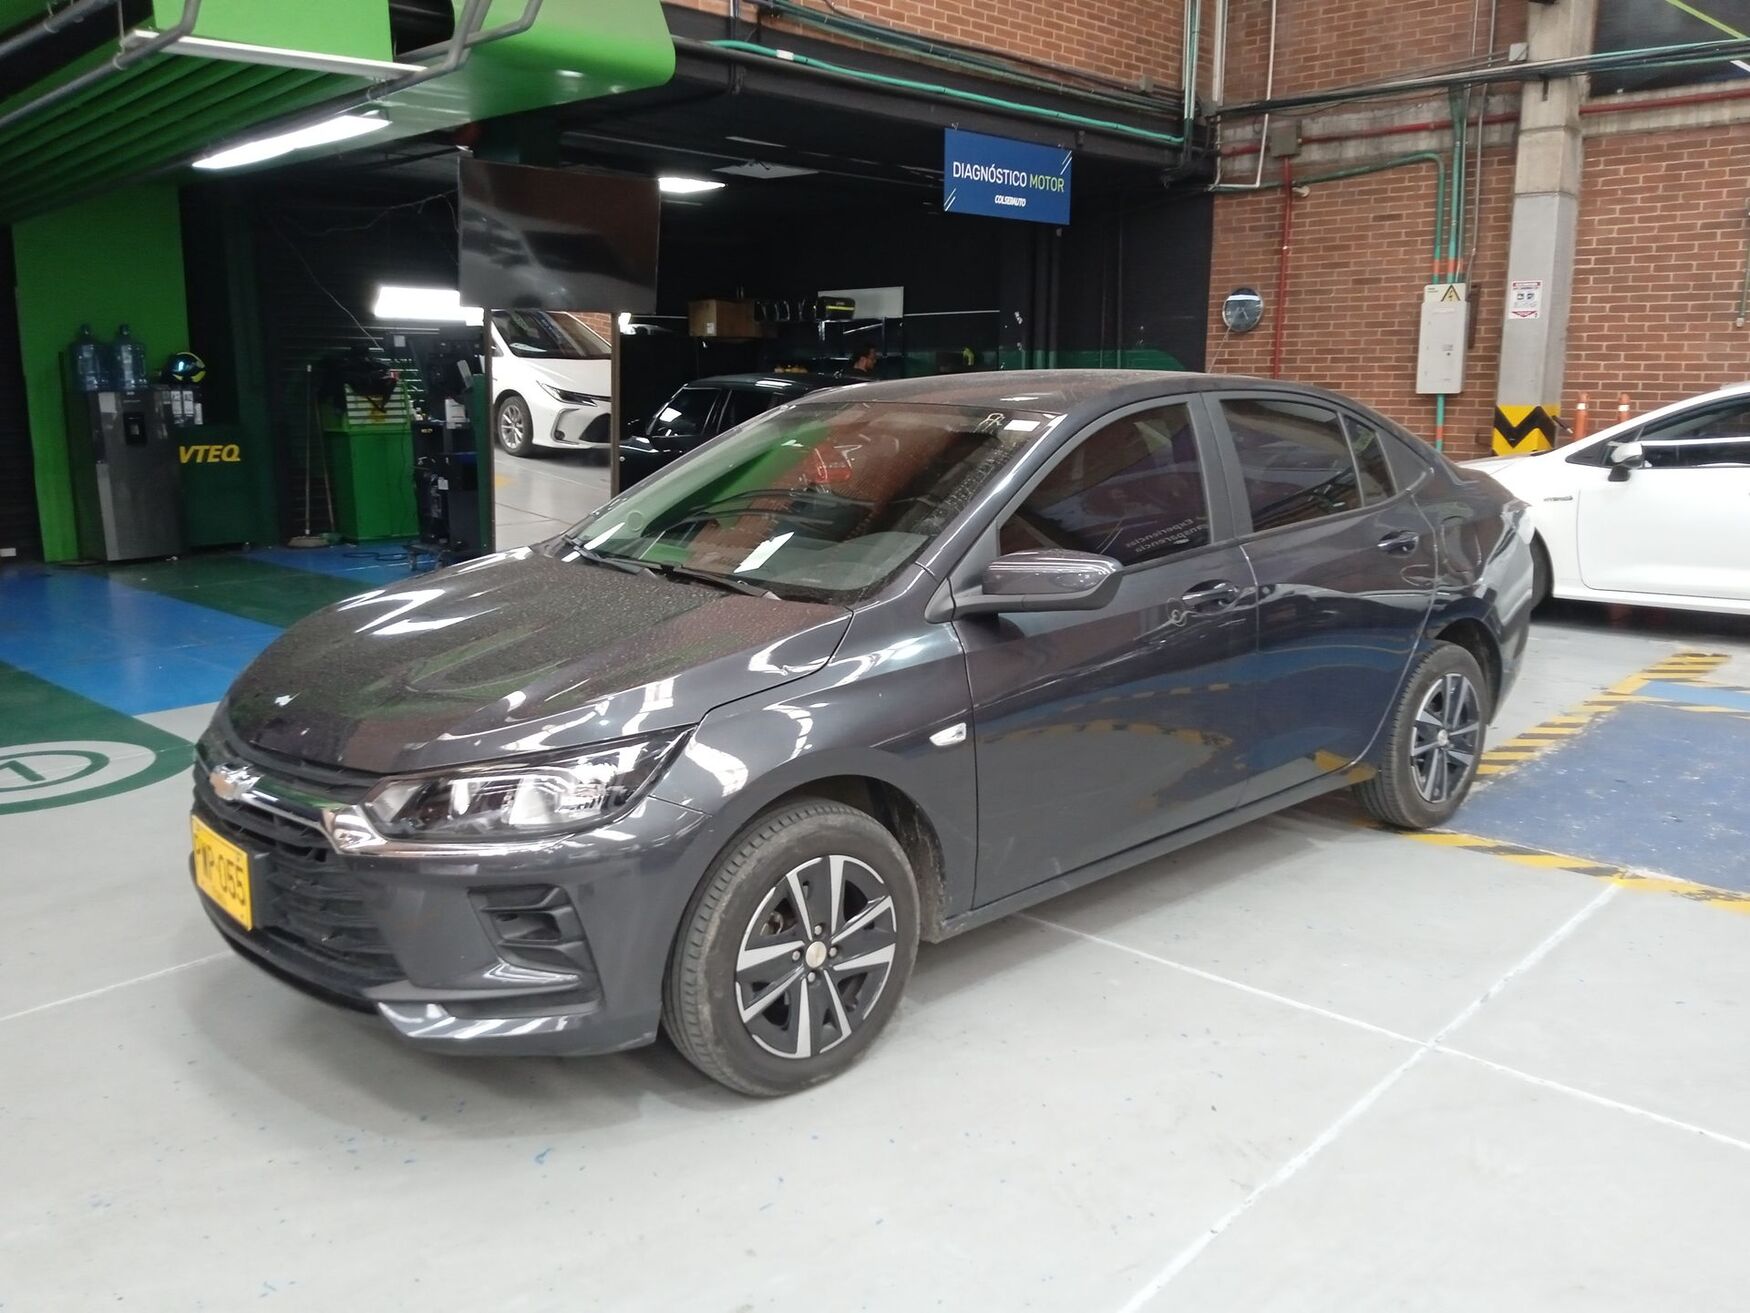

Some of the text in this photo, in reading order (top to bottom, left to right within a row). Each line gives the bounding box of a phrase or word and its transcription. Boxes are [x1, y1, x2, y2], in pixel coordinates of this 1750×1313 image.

[953, 161, 1065, 193] DIAGNÓSTICO MOTOR
[179, 444, 241, 464] VTEQ
